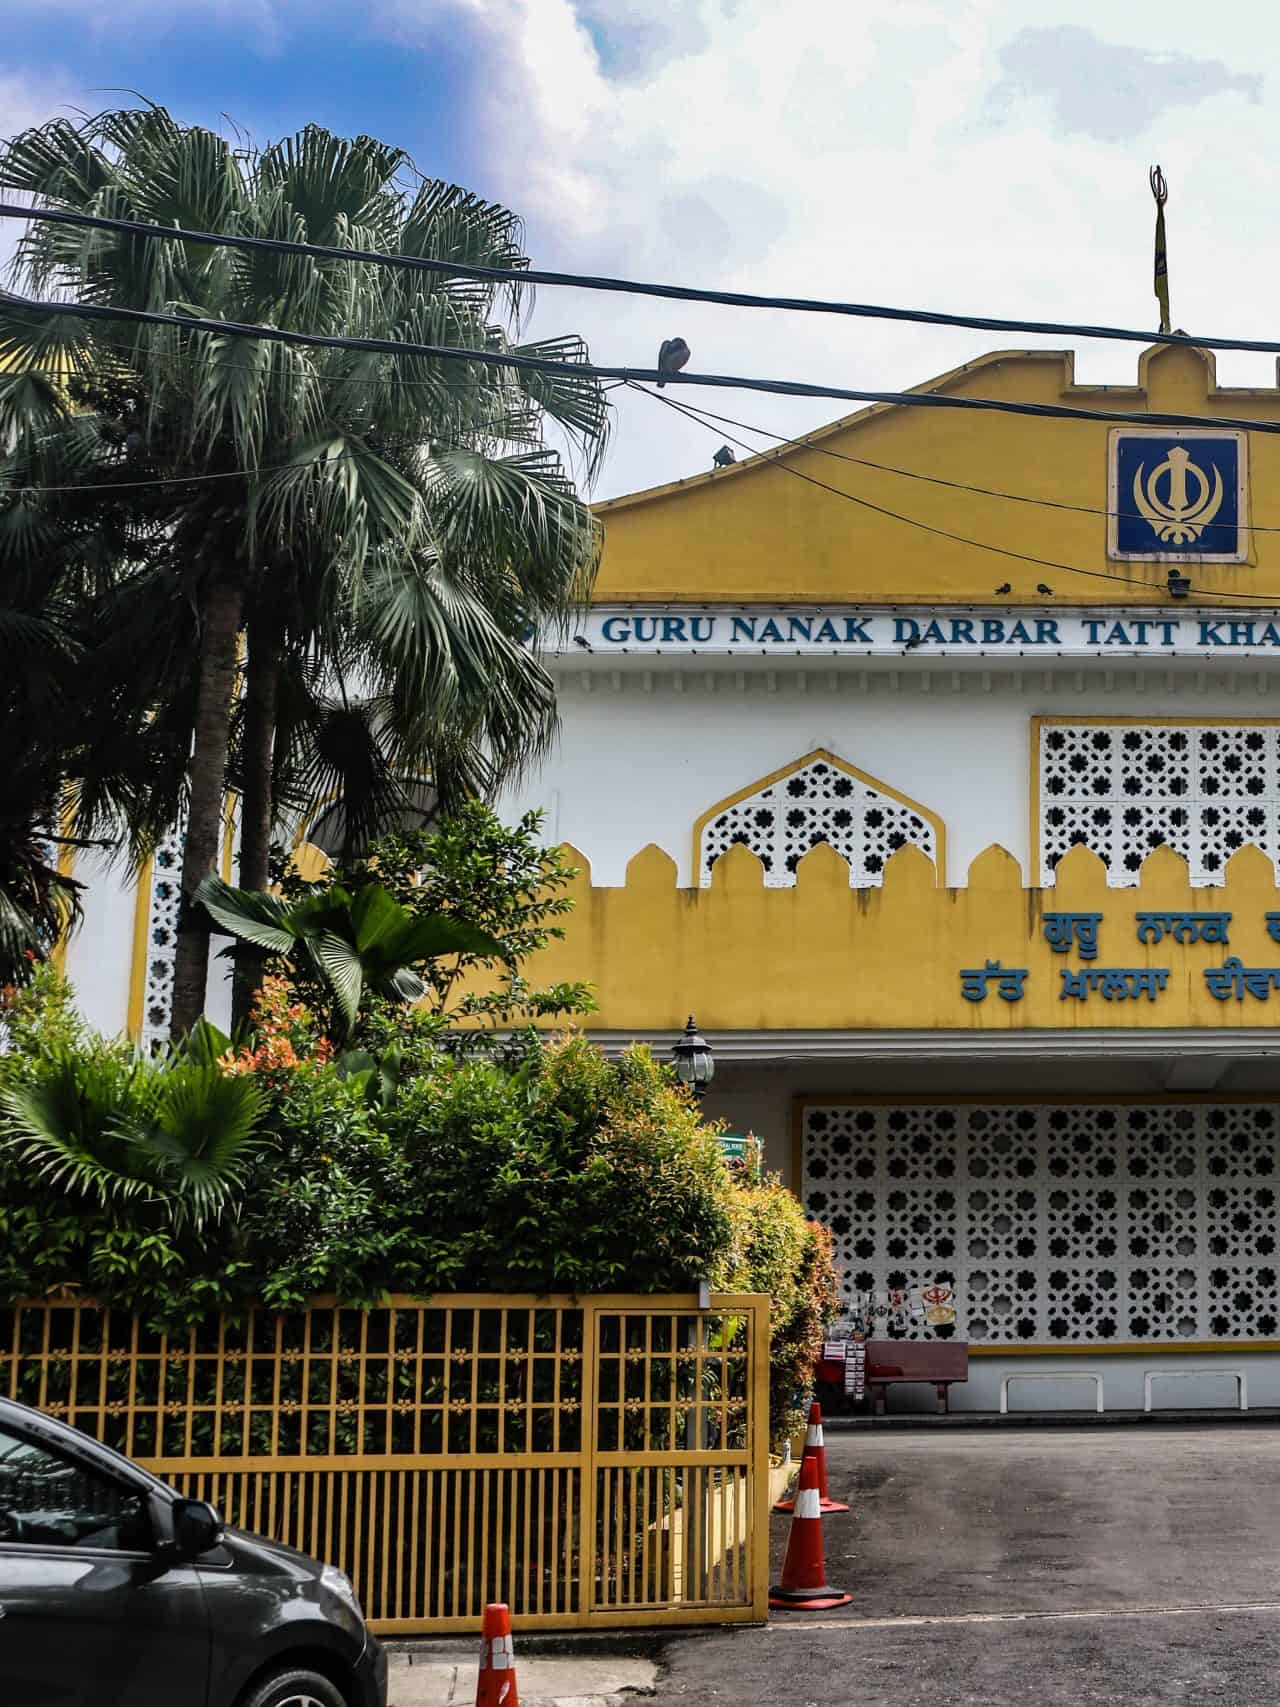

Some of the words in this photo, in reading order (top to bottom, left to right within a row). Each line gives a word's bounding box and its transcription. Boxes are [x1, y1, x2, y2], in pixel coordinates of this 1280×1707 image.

[601, 616, 716, 643] GURU
[731, 616, 874, 645] NANAK
[893, 618, 1062, 646] DARBAR
[1081, 620, 1180, 647] TATT
[1043, 912, 1103, 960] ਗੁਰੂ
[1135, 912, 1233, 945] ਨਾਨਕ
[960, 960, 1029, 1001] ਤੱਤ
